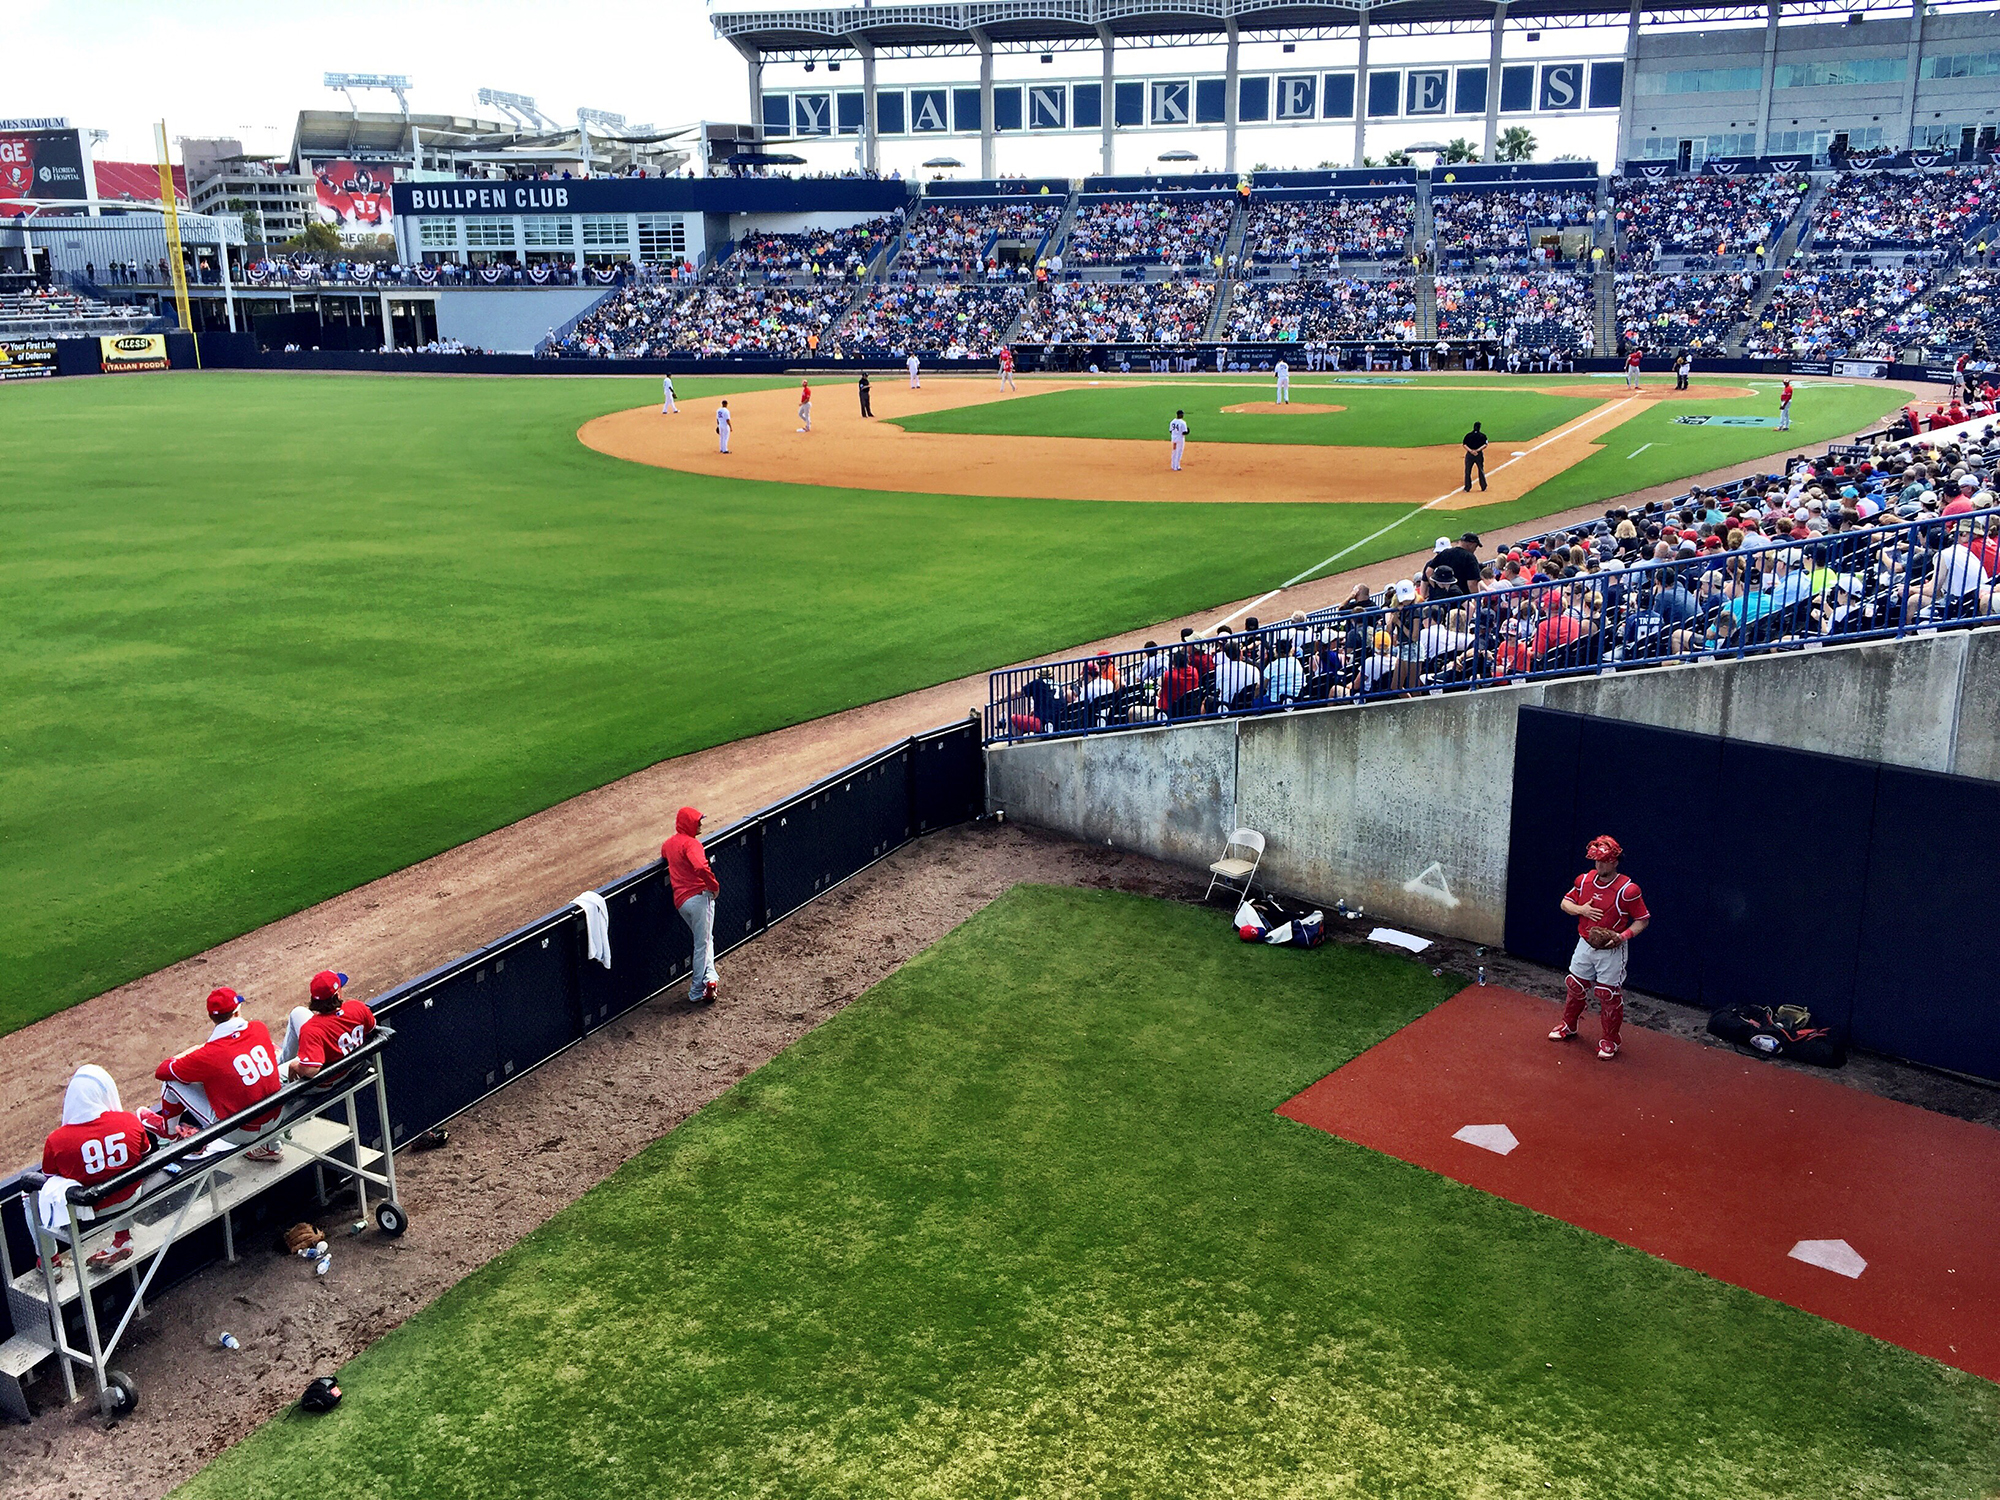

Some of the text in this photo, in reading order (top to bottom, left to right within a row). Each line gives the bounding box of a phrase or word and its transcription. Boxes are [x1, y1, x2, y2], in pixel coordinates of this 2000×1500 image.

[797, 67, 1575, 133] YANKEES
[20, 117, 65, 128] STADIUM
[53, 173, 80, 181] HOSPITAL
[411, 188, 569, 209] BULLPEN CLUB
[354, 200, 376, 214] 93
[10, 341, 56, 351] Your First Line
[118, 339, 148, 349] ALESSI
[17, 351, 51, 360] of Defense
[107, 361, 165, 371] ITALIAN FOODS
[233, 1045, 274, 1086] 98
[80, 1131, 129, 1176] 95
